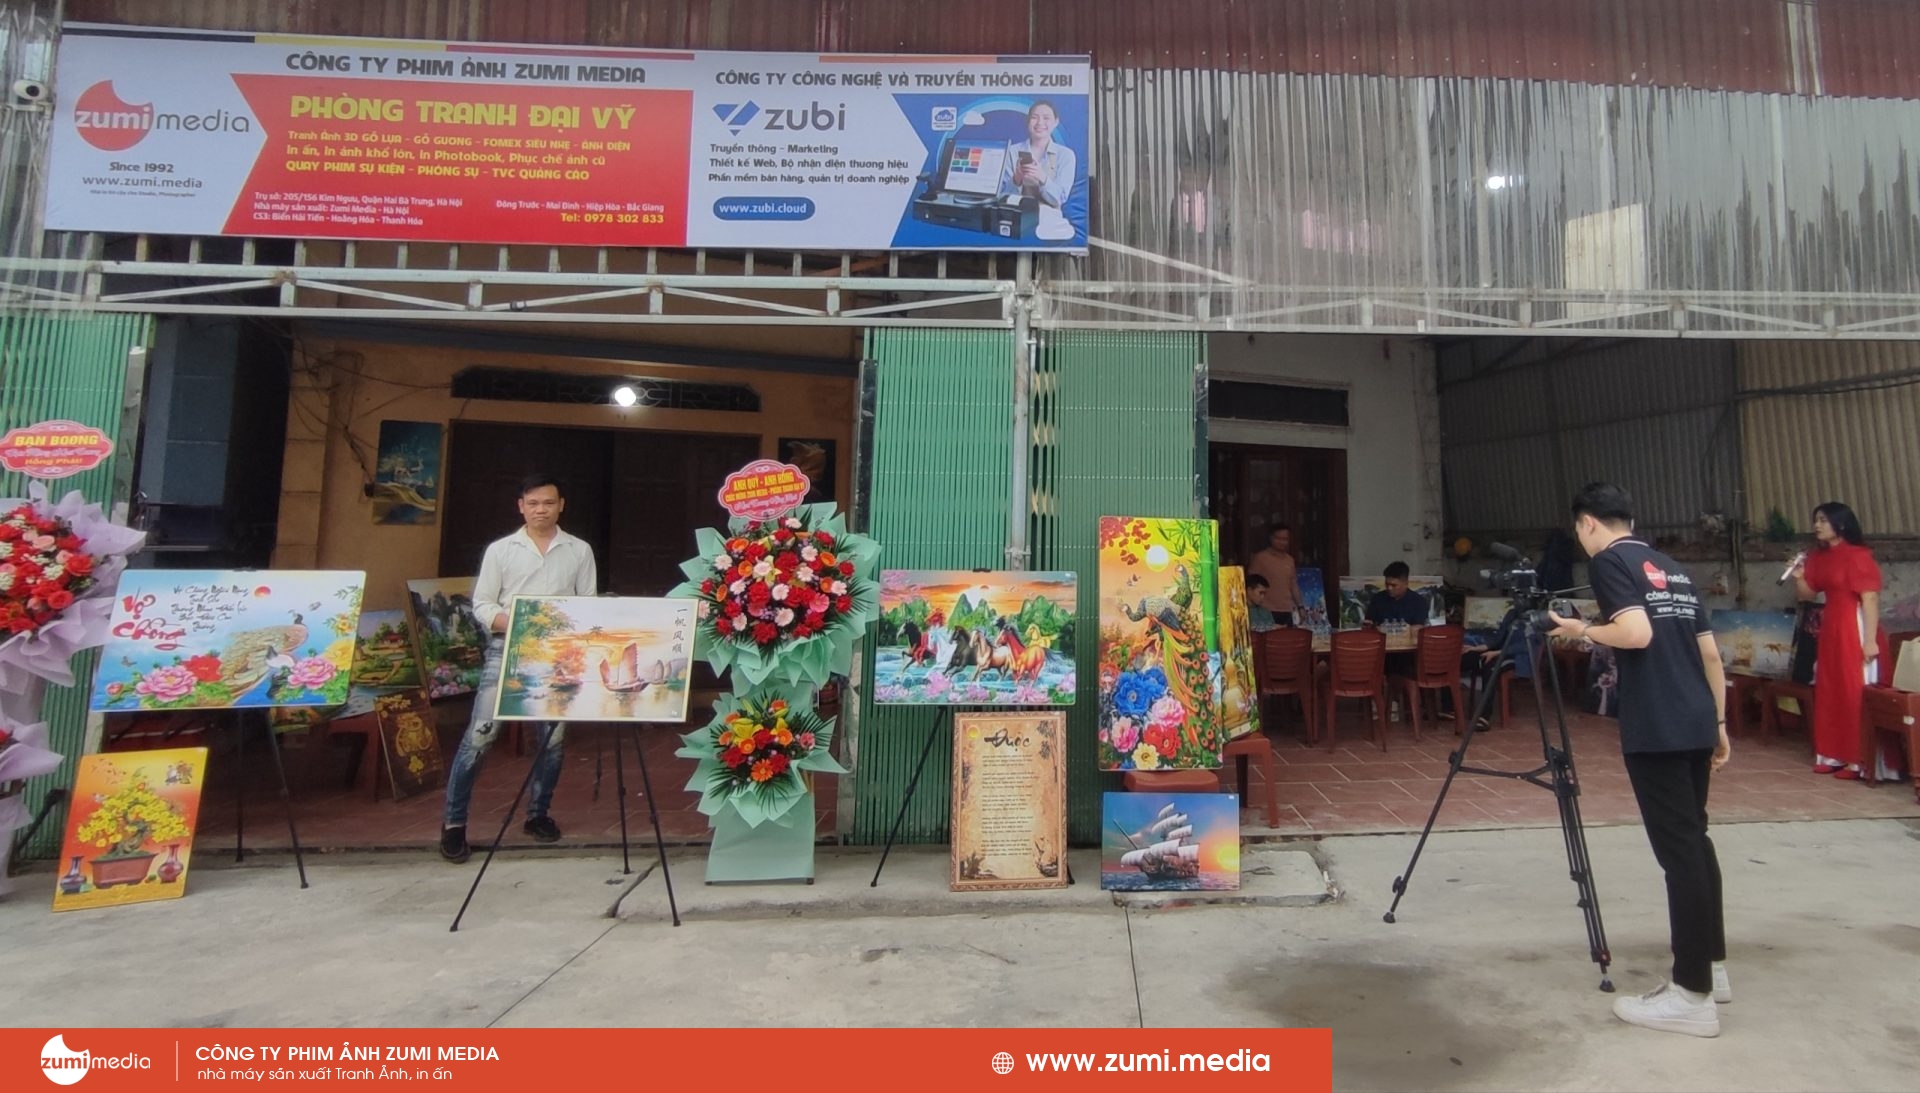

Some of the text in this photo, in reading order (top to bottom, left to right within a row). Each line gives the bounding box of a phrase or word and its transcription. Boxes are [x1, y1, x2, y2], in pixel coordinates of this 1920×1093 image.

[286, 51, 645, 83] CÔNG TY PHIM ẢNH ZUMI MEDIA
[715, 70, 760, 85] CÔNG
[766, 73, 786, 85] TY
[792, 70, 836, 85] CÔNG
[841, 71, 882, 89] NGHỆ
[888, 72, 909, 86] VÀ
[981, 71, 1033, 87] THÔNG
[1040, 75, 1073, 87] ZUBI
[290, 92, 637, 133] PHÒNG TRANH ĐẠI VỸ
[764, 101, 846, 131] zubi
[288, 131, 317, 140] Tranh
[344, 132, 358, 142] 3D
[483, 138, 522, 149] FOMEX
[748, 144, 777, 155] thông
[787, 145, 838, 156] Marketing
[434, 149, 505, 163] Photobook,
[509, 152, 538, 166] Phục
[709, 157, 734, 167] Thiết
[738, 157, 750, 167] kế
[753, 158, 778, 168] Web,
[781, 158, 794, 169] Bộ
[797, 158, 821, 170] nhận
[825, 159, 846, 170] diện
[887, 159, 909, 170] hiệu
[109, 162, 174, 173] Since 1992
[286, 160, 320, 172] QUAY
[324, 161, 356, 172] PHIM
[378, 161, 405, 176] KIỆN
[492, 168, 515, 178] TVC
[519, 167, 561, 180] QUẢNG
[82, 176, 203, 189] www.zumi.media
[847, 174, 876, 183] doanh
[879, 174, 910, 185] nghiệp
[254, 192, 268, 201] Trụ
[283, 192, 318, 202] 205/156
[319, 194, 335, 202] Kim
[361, 195, 383, 205] Quận
[384, 196, 397, 204] Hai
[398, 197, 409, 205] Bà
[436, 198, 447, 206] Hà
[449, 198, 463, 208] Nội
[254, 202, 270, 210] Nhà
[330, 204, 350, 213] Zumi
[351, 205, 377, 214] Media
[383, 206, 394, 214] Hà
[395, 206, 409, 216] Nội
[546, 202, 560, 210] Mai
[586, 202, 604, 212] Hiệp
[641, 203, 664, 213] Giang
[719, 203, 807, 214] www.zubi.cloud
[381, 216, 406, 225] Thanh
[560, 213, 664, 224] Tel: 0978 302 833
[15, 436, 46, 448] BẠN
